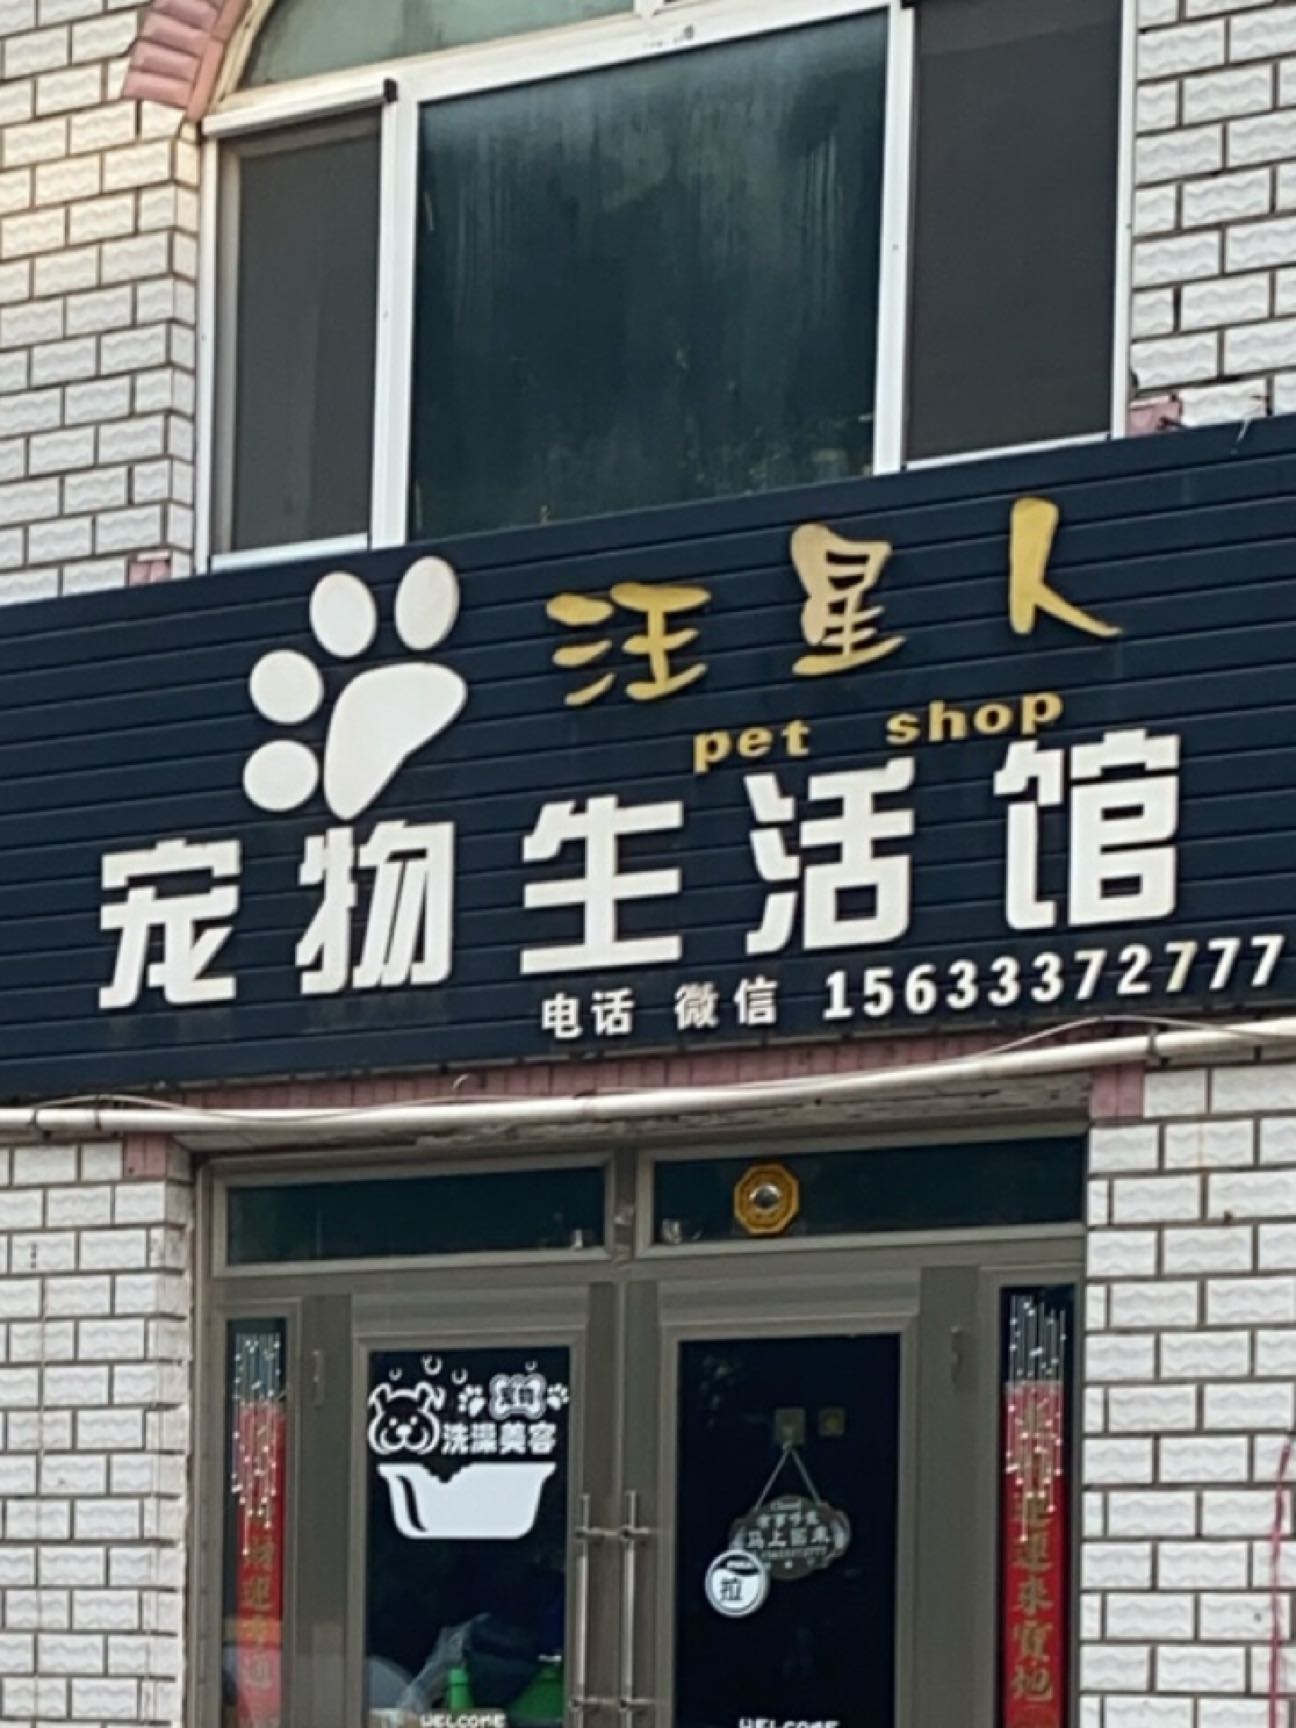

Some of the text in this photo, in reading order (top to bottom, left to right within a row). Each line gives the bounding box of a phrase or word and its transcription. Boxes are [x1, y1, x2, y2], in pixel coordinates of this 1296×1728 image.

[547, 498, 1121, 706] 汪星人
[695, 692, 1063, 773] pet shop
[99, 728, 1181, 1009] 宠物生活馆
[542, 933, 1286, 1038] 电话 微信 15633372777
[440, 1420, 557, 1455] 洗澡美容
[720, 1576, 742, 1600] 拉
